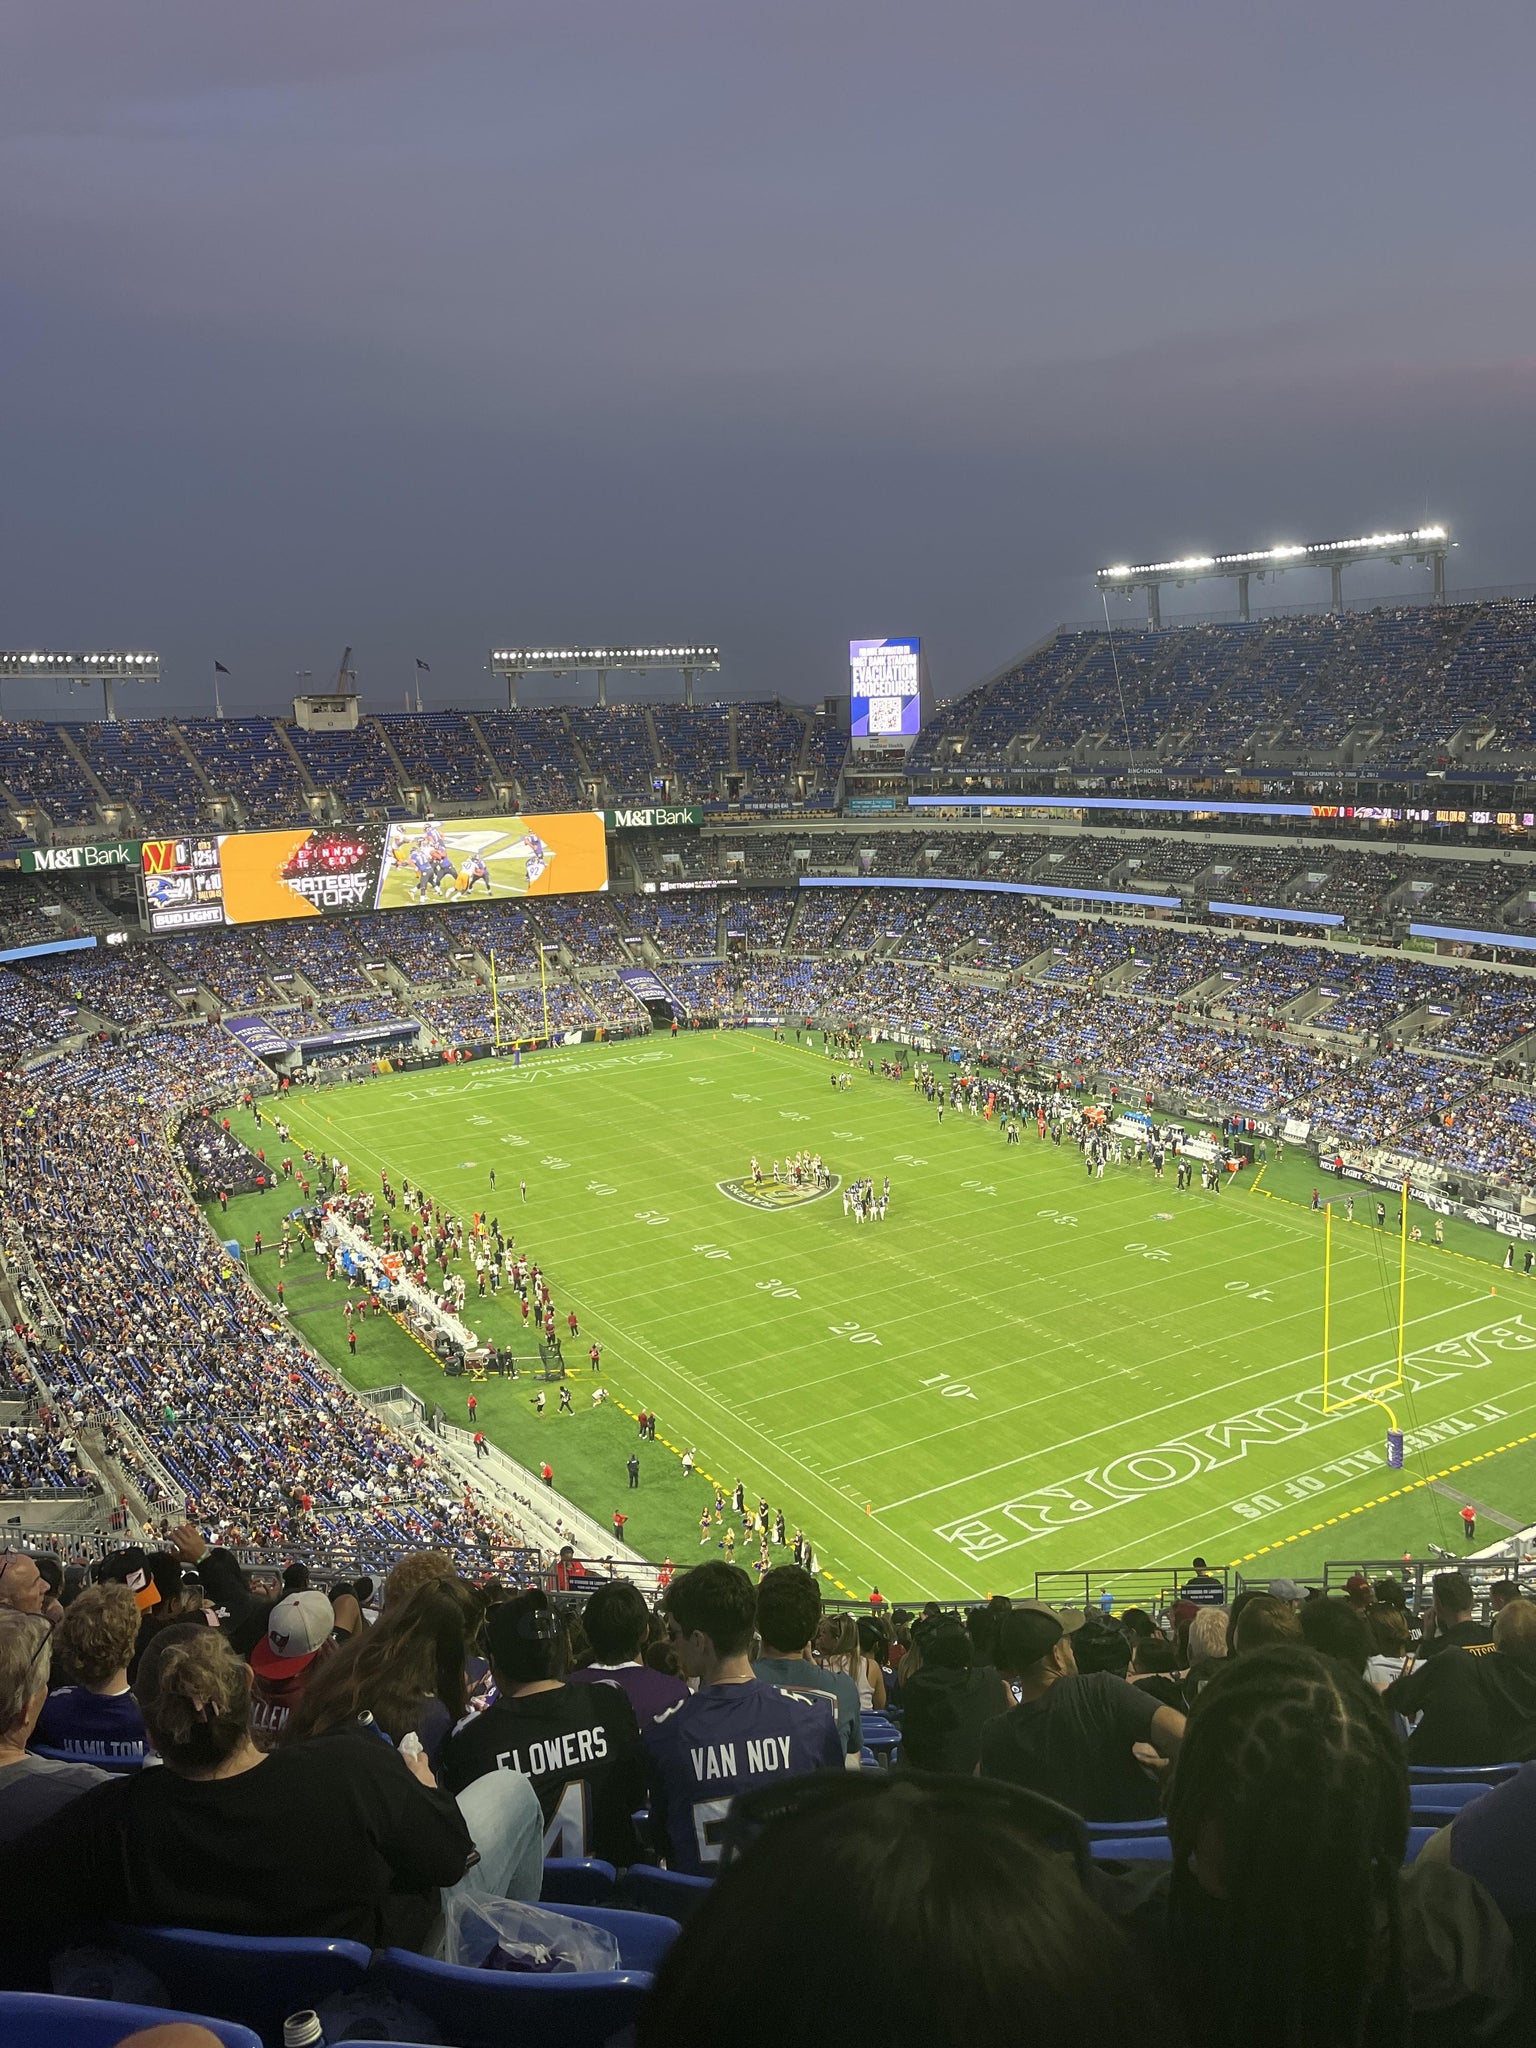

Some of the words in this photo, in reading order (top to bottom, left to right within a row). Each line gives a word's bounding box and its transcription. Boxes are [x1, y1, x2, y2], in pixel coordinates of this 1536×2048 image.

[869, 656, 886, 666] BANK
[888, 654, 916, 665] STADIUM
[853, 664, 917, 682] EVACUATION
[853, 680, 918, 698] PROCEDURES
[614, 808, 656, 828] M&T
[656, 807, 694, 826] Bank
[1436, 810, 1449, 821] BALL
[1449, 811, 1457, 822] ON
[1497, 812, 1510, 824] QTR
[1510, 813, 1517, 824] 3
[32, 847, 84, 871] M&T
[84, 844, 131, 867] Bank
[176, 844, 186, 864] 0
[193, 849, 217, 867] 12:51
[178, 878, 193, 900] 24
[211, 874, 221, 890] 10
[156, 913, 181, 925] BUD
[183, 910, 219, 922] LIGHT
[391, 1051, 674, 1102] RAVENS
[1245, 1118, 1273, 1136] 196
[540, 1156, 572, 1170] 30
[893, 1154, 929, 1167] 50
[1320, 1160, 1336, 1172] NEXT
[1341, 1167, 1363, 1180] LIGHT
[585, 1180, 618, 1196] 40
[726, 1184, 775, 1208] RAVENS
[960, 1180, 997, 1197] 40
[1386, 1180, 1404, 1193] NEXT
[634, 1209, 670, 1225] 50
[1036, 1208, 1079, 1227] 30
[1489, 1206, 1523, 1221] TRUST
[692, 1243, 729, 1260] 40
[1124, 1243, 1171, 1263] 20
[755, 1278, 798, 1298] 30
[1224, 1281, 1274, 1302] 10
[828, 1321, 877, 1344] 20
[918, 1372, 971, 1398] 10
[1472, 1403, 1509, 1422] IT
[934, 1315, 1536, 1561] BALTIMORE
[1403, 1417, 1478, 1454] TAKES
[1322, 1450, 1385, 1478] ALL
[1284, 1475, 1326, 1499] OF
[1231, 1494, 1284, 1519] US
[251, 1702, 290, 1731] LLEN
[63, 1738, 144, 1758] HAMILTON
[496, 1726, 608, 1778] FLOWERS
[691, 1743, 738, 1782] VAN
[747, 1735, 792, 1774] NOY
